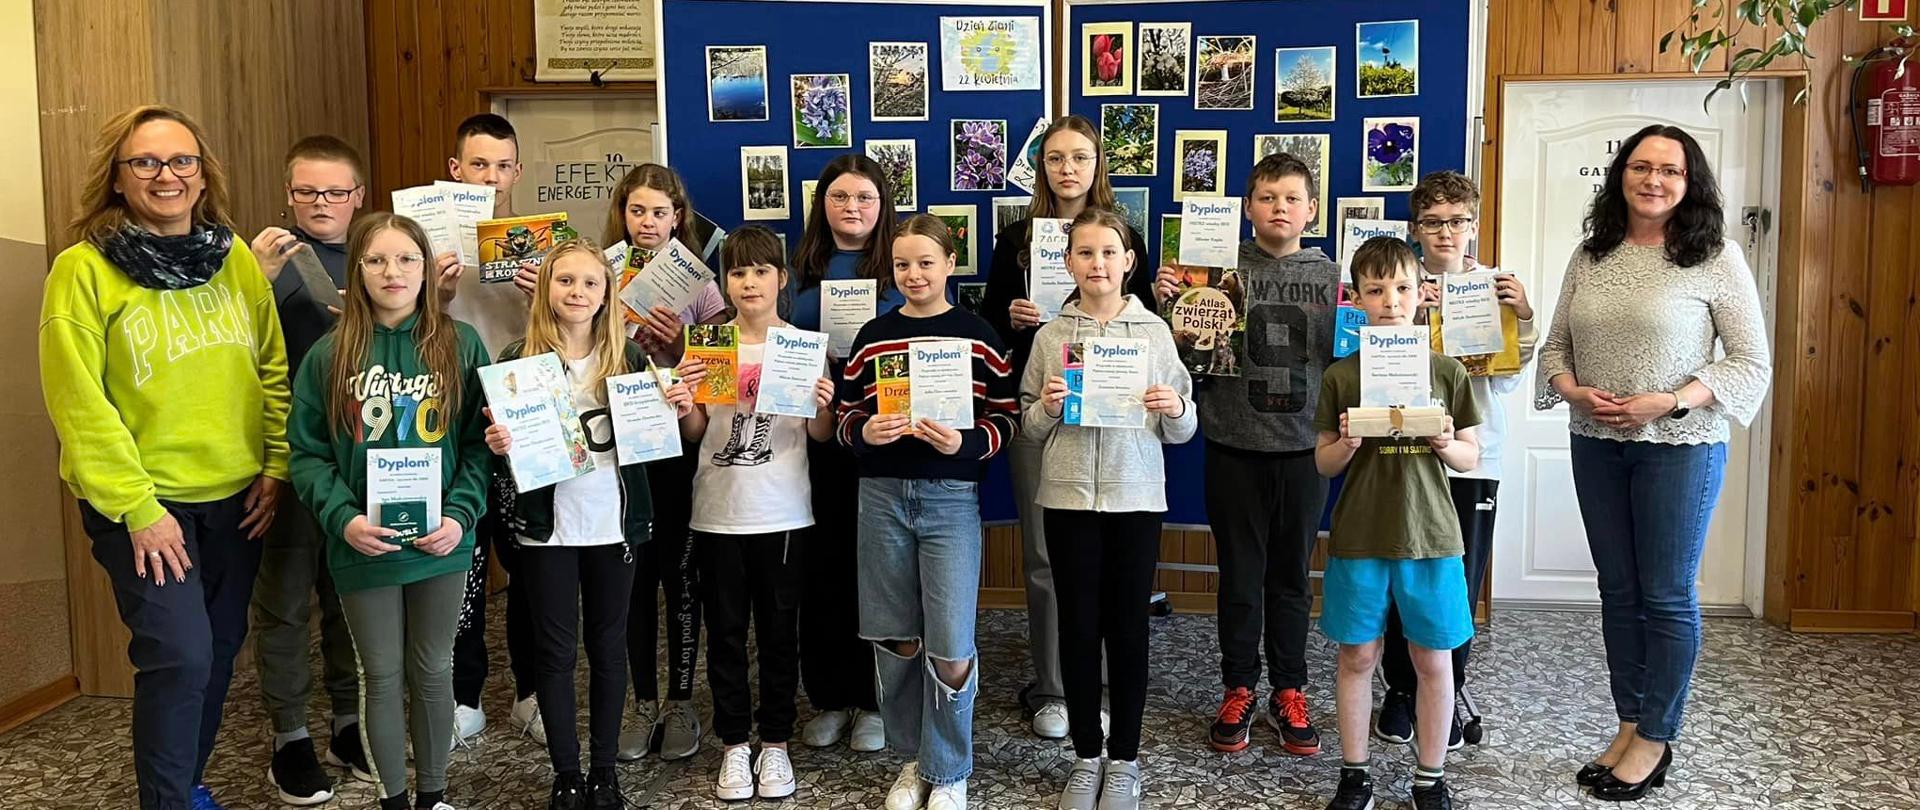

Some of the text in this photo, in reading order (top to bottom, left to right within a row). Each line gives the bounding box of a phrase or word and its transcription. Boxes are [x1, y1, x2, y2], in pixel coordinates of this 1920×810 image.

[555, 163, 637, 184] EFEKT
[1190, 203, 1231, 216] Dyplom
[1353, 226, 1396, 239] Dyplom
[1041, 248, 1065, 261] Dypl
[669, 248, 702, 281] Dyplom
[831, 286, 869, 298] Dyplom
[1273, 281, 1329, 305] YORK
[1447, 281, 1489, 295] Dyplom
[1199, 299, 1226, 309] Atlas
[1175, 304, 1233, 322] zwierząt
[1183, 316, 1223, 330] Polski
[776, 334, 819, 349] Dyplom
[1369, 333, 1418, 348] Dyplom
[917, 349, 961, 363] Dyplom
[1093, 344, 1138, 357] Dyplom
[505, 403, 547, 420] Dyplom
[378, 457, 430, 471] Dyplom
[677, 612, 695, 644] good
[681, 647, 695, 665] for
[677, 667, 690, 690] you
